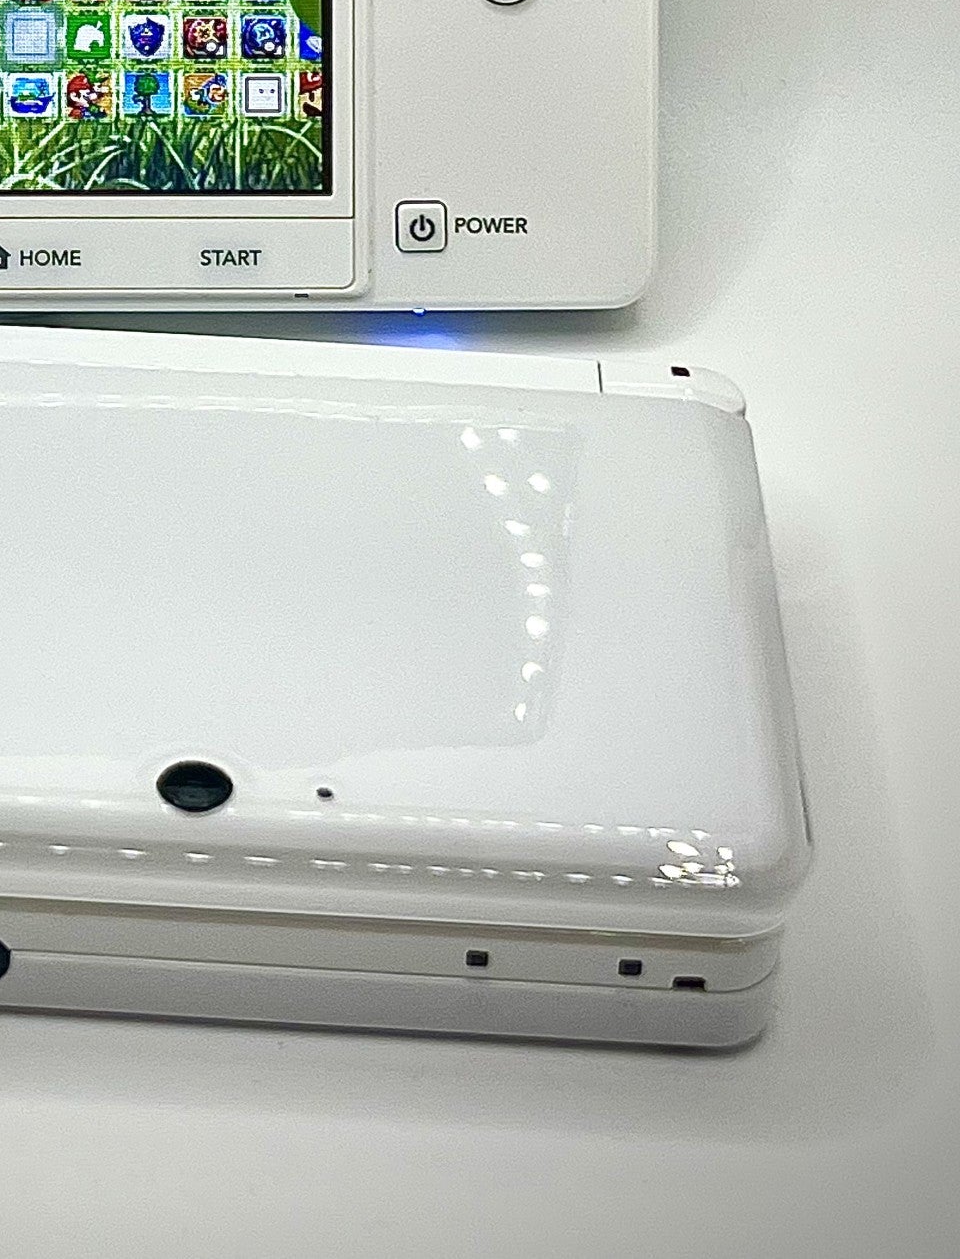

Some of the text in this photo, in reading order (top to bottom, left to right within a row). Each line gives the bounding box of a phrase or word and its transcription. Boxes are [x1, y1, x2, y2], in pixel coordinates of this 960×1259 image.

[453, 216, 529, 235] POWER
[18, 248, 82, 267] HOME
[199, 248, 263, 267] START
